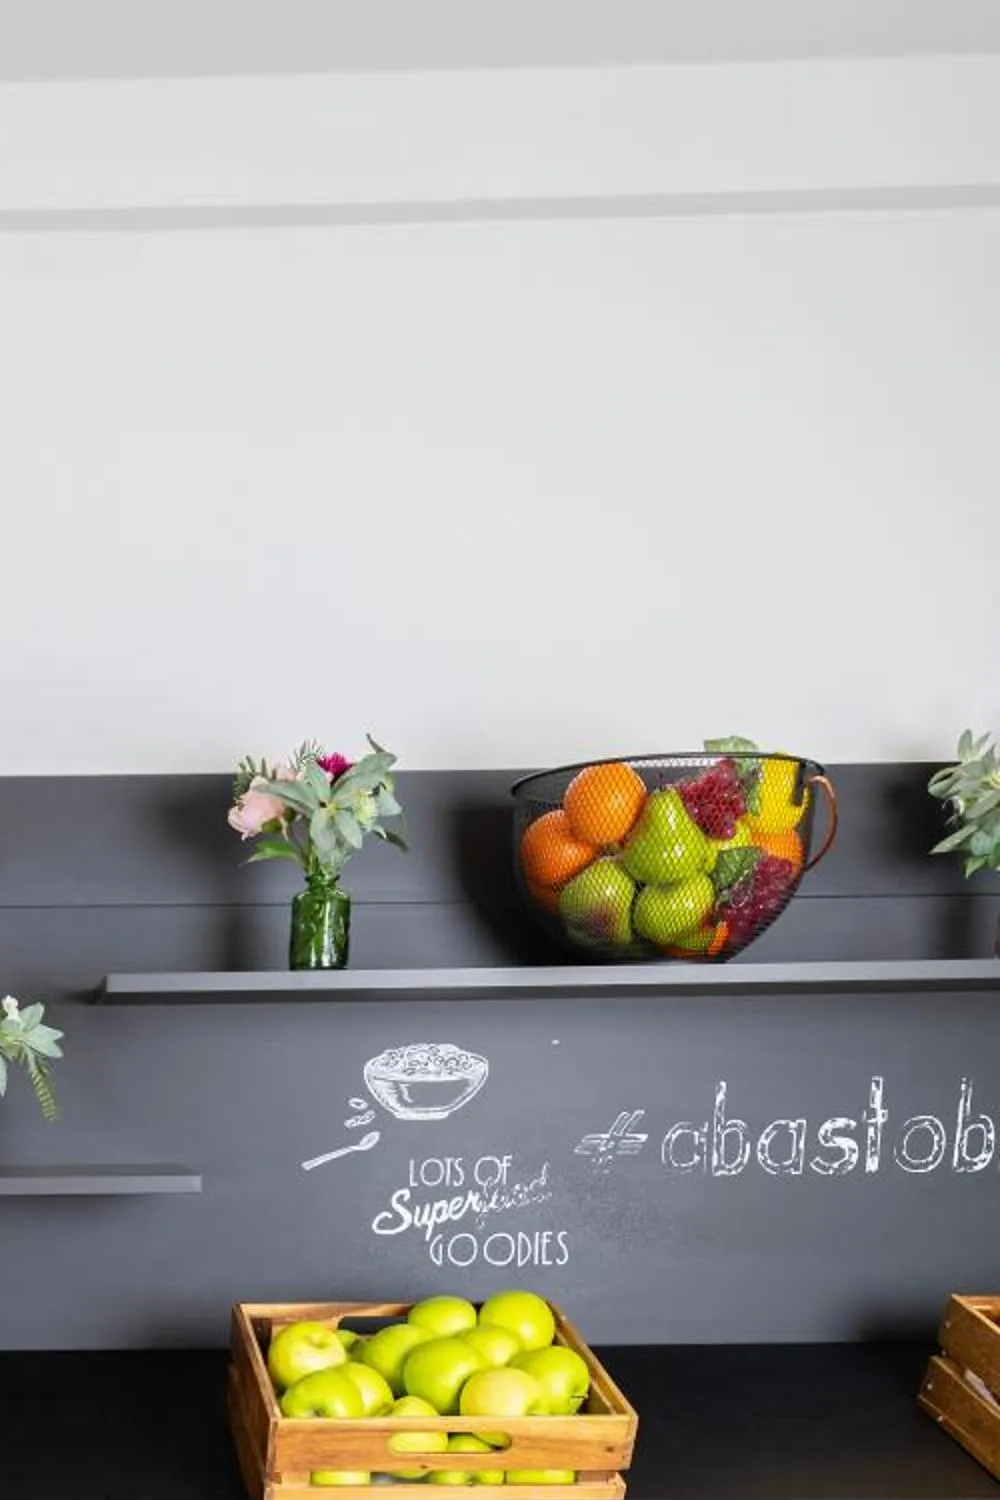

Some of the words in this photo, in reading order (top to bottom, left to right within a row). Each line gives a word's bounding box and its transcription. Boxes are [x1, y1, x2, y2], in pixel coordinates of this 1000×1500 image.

[408, 1157, 466, 1188] LOTS
[474, 1154, 513, 1187] OF
[429, 1231, 570, 1268] GOODIES
